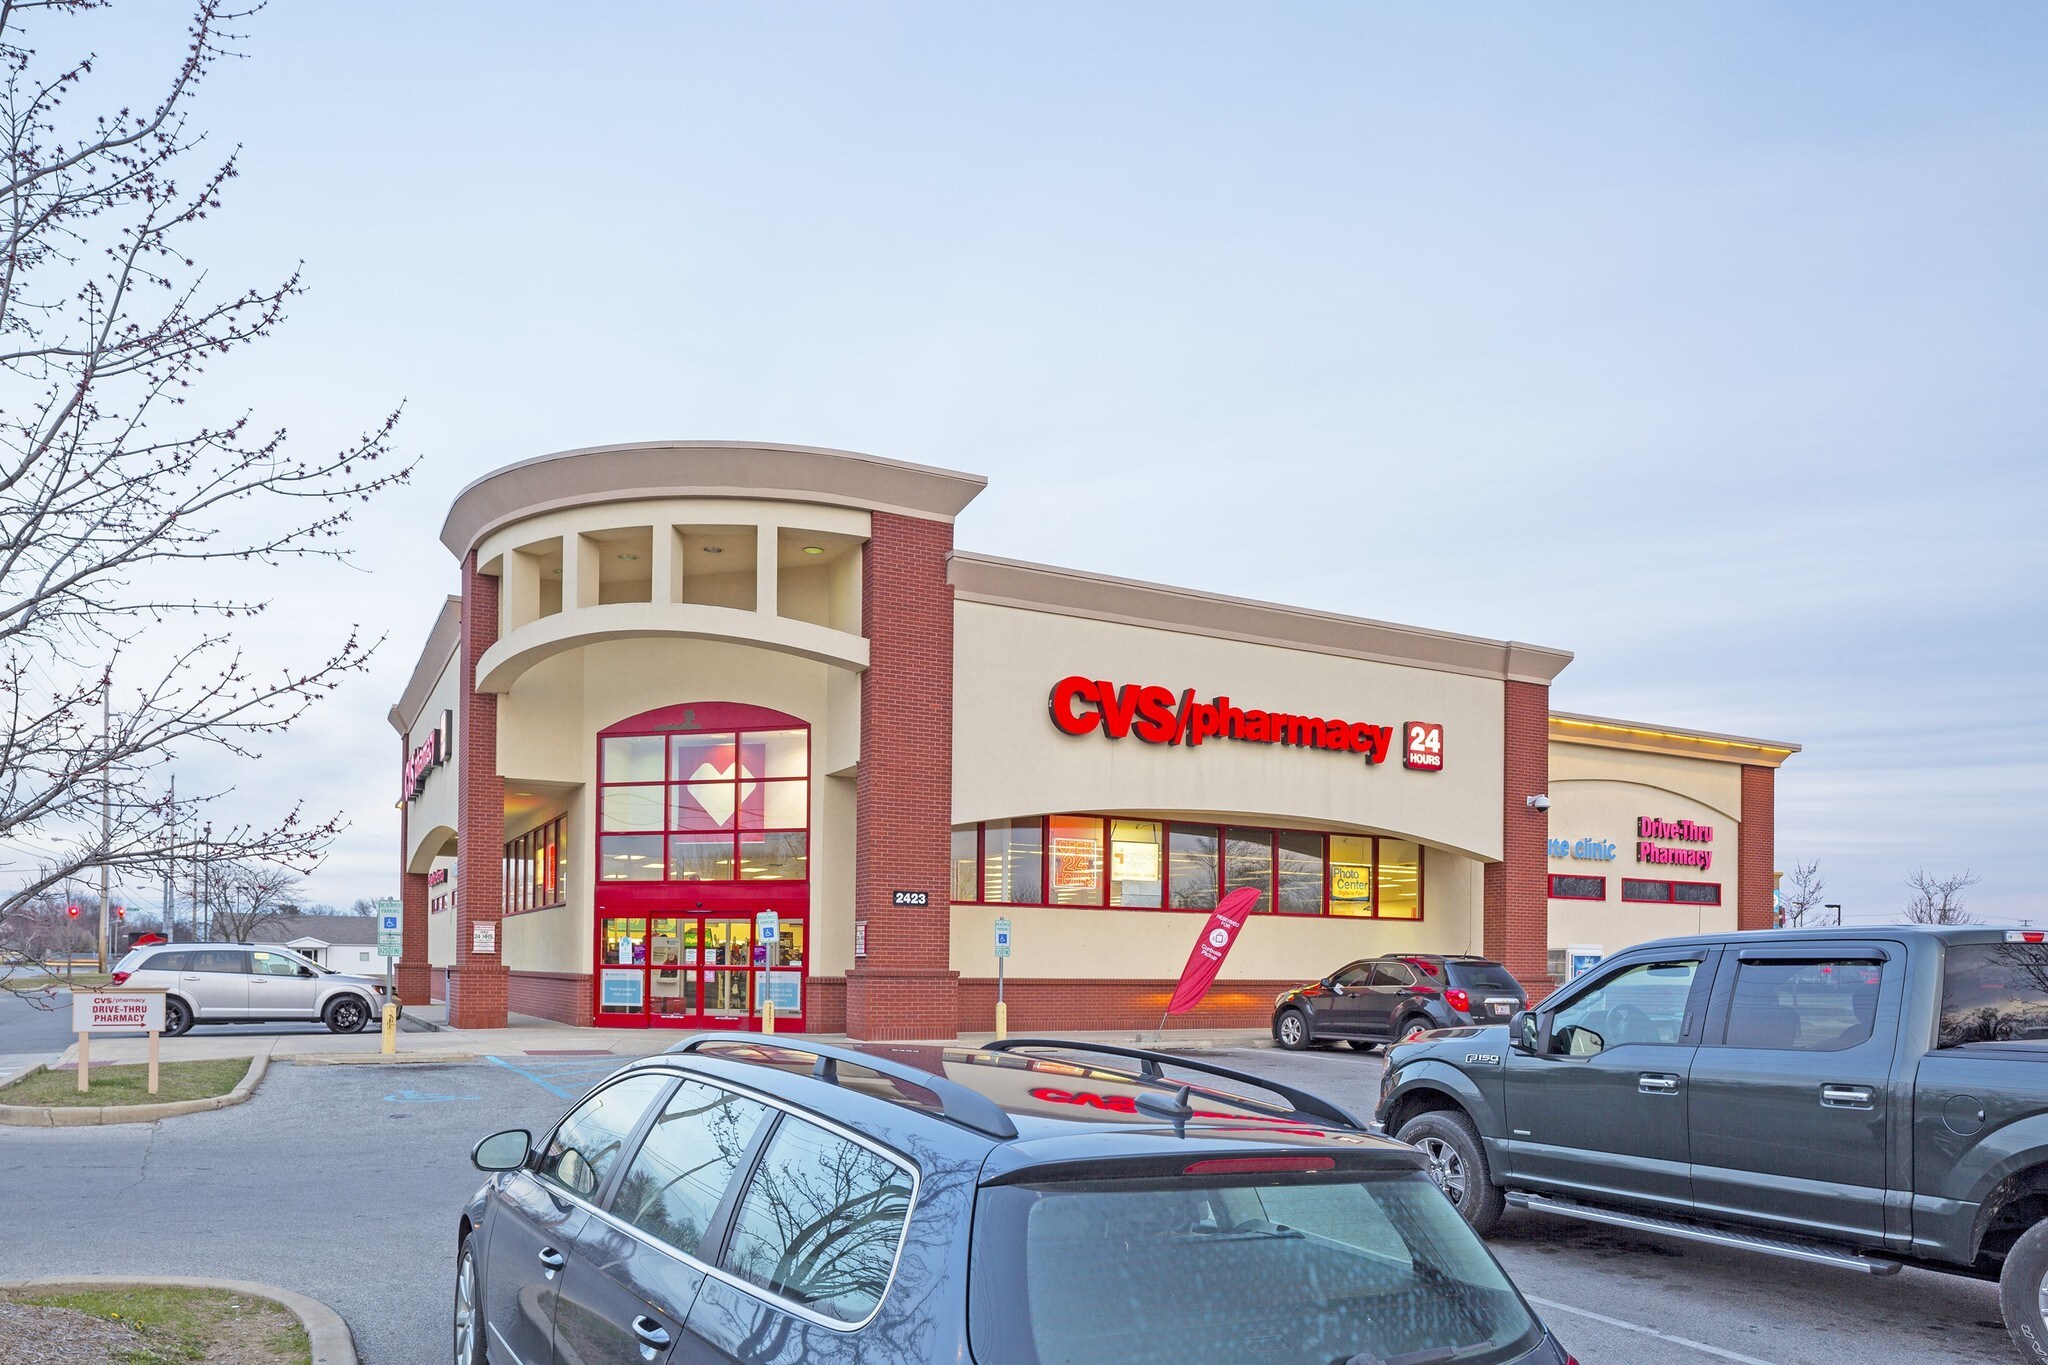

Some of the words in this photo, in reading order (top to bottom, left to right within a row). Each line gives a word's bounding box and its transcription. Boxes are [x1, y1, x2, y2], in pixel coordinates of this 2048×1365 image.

[1050, 675, 1394, 764] CVS/pharmacy
[1410, 726, 1441, 753] 24
[1410, 753, 1441, 766] HOURS
[1638, 816, 1714, 843] Drive-Thru
[1058, 840, 1093, 854] OPEN
[1574, 837, 1616, 860] clinic
[1638, 841, 1713, 870] Pharmacy
[1063, 855, 1088, 873] 24
[1056, 872, 1094, 887] HOURS
[1333, 867, 1359, 879] Photo
[1337, 879, 1369, 890] Center
[895, 892, 926, 904] 2423
[1215, 913, 1240, 928] RESERVED
[1220, 921, 1231, 929] FOR
[1200, 949, 1218, 961] Pickup
[92, 1005, 147, 1013] DRIVE-THRU
[94, 1014, 145, 1022] PHARMACY
